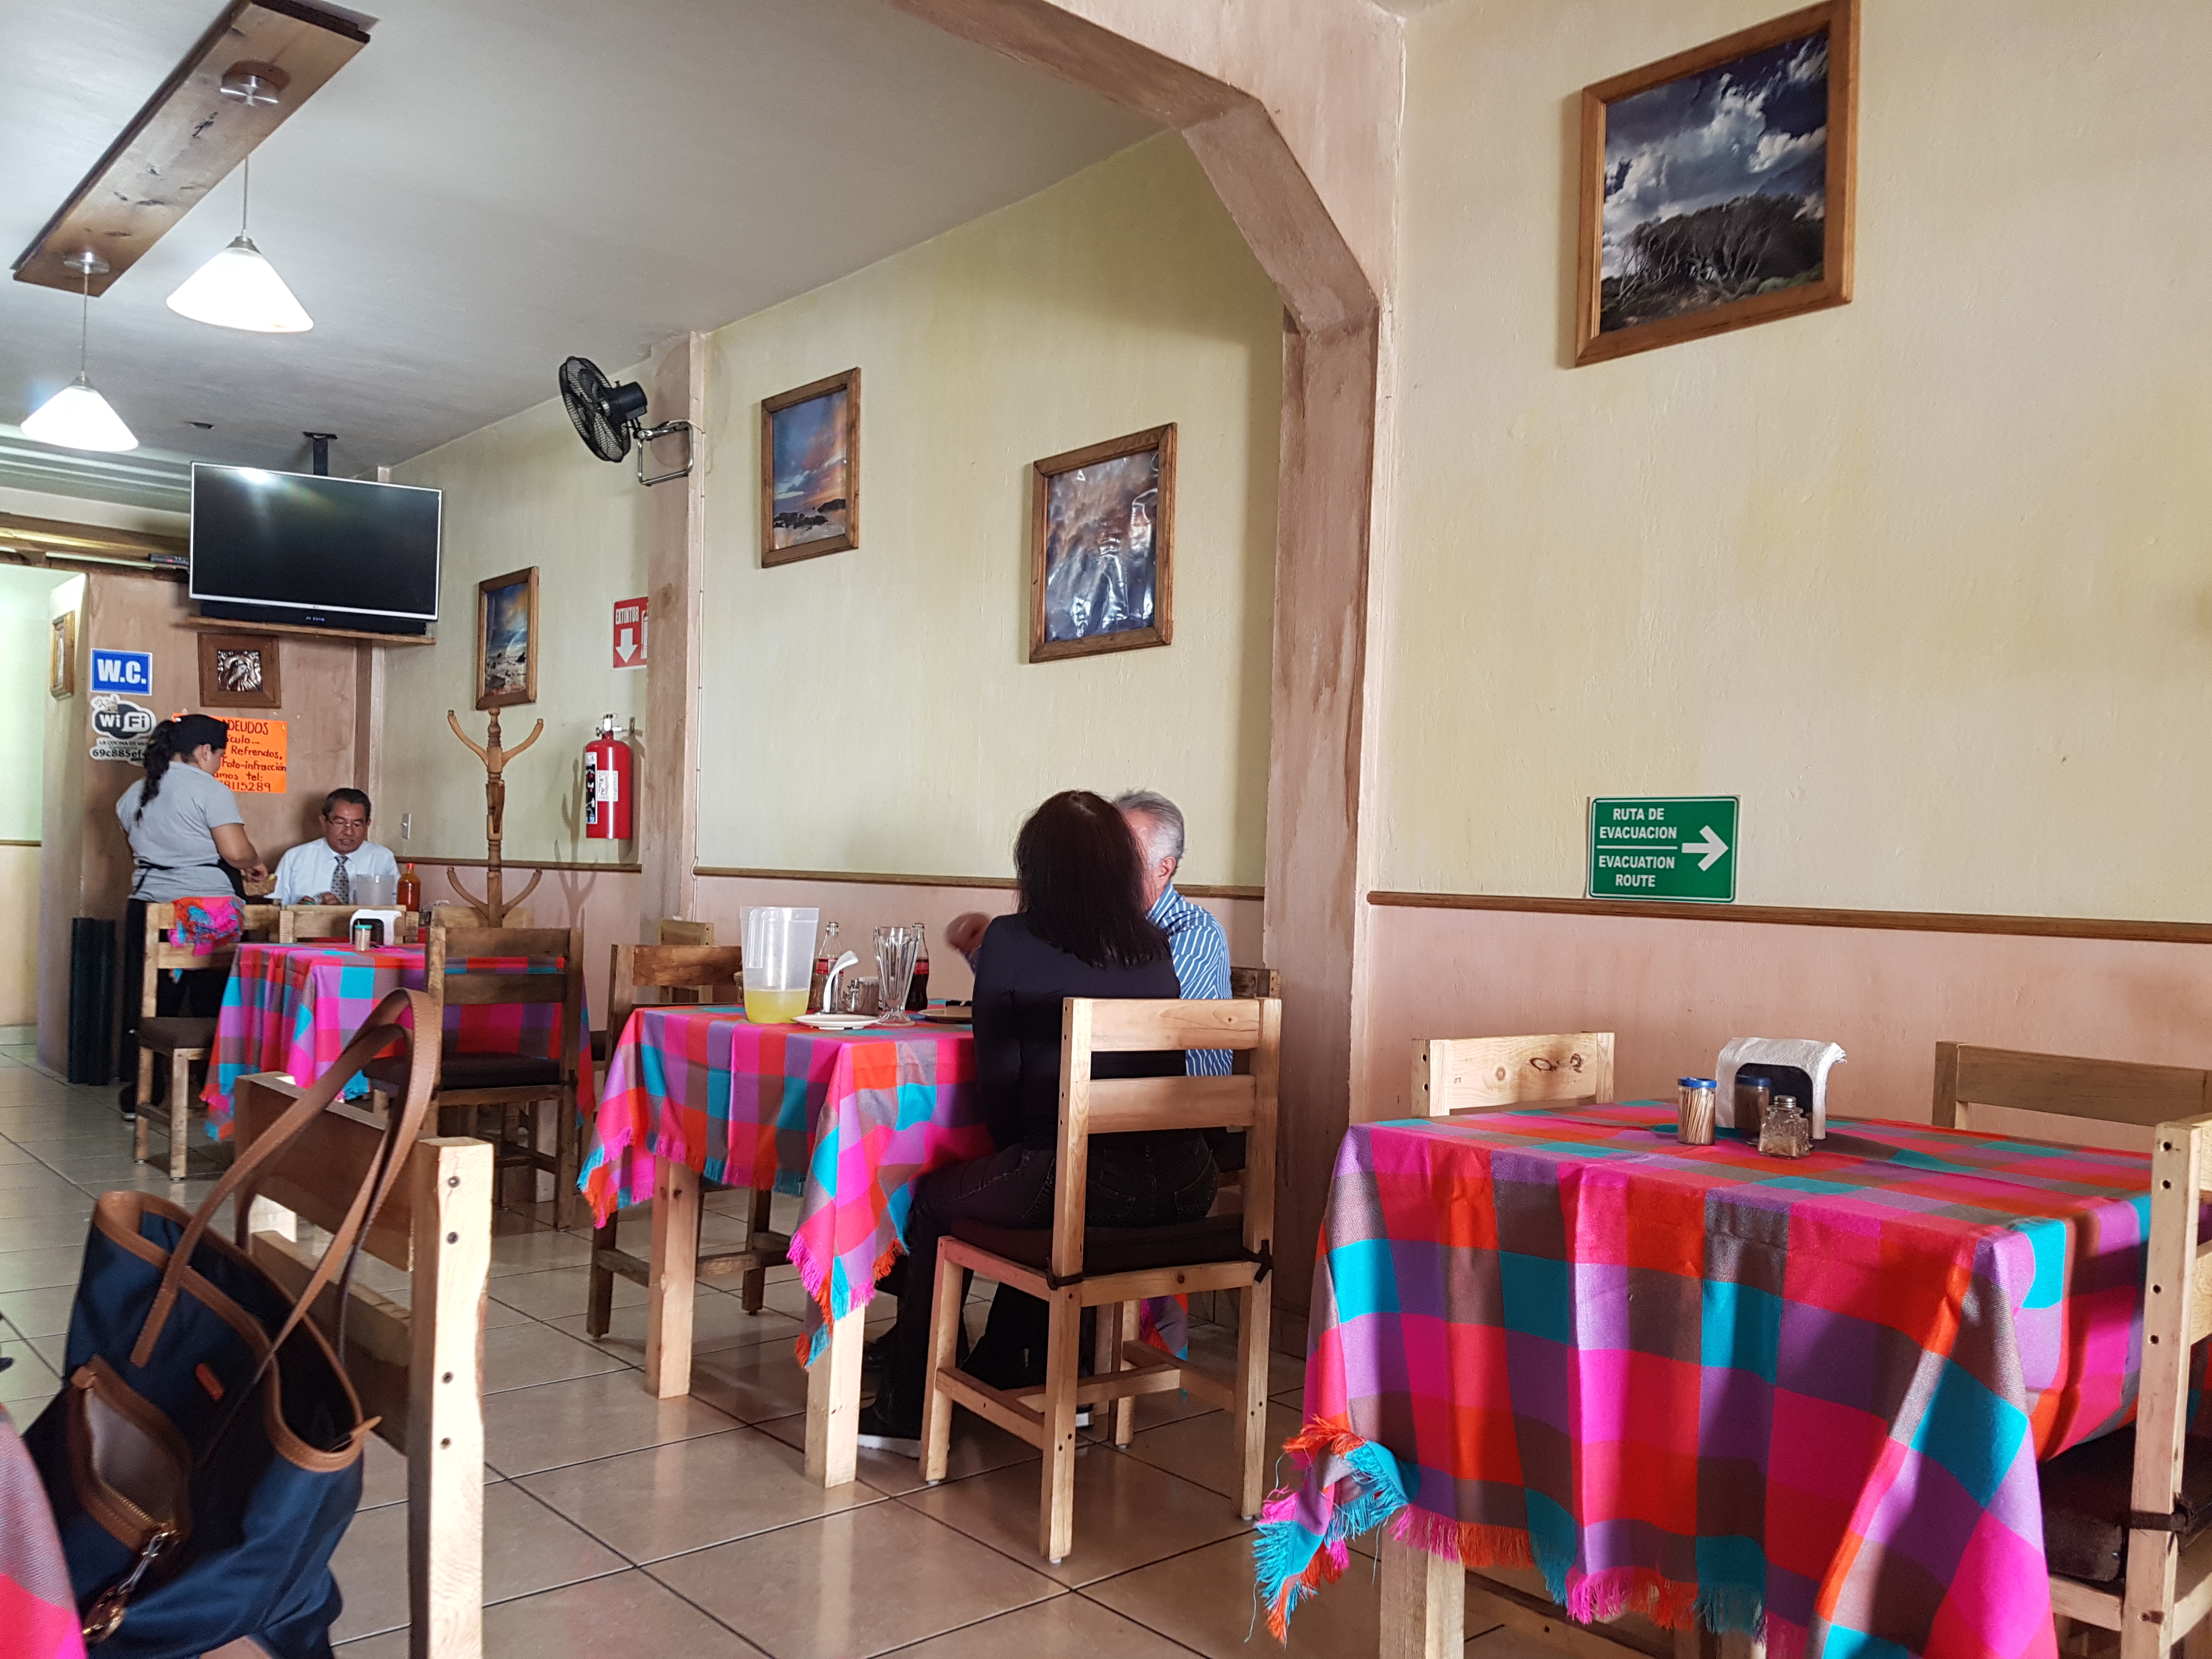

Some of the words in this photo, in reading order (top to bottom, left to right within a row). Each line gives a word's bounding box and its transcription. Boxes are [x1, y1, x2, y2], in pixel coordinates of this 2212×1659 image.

[616, 606, 639, 625] EXTINTOR
[97, 658, 146, 684] W.C.
[246, 771, 263, 781] tel:
[221, 780, 271, 792] 8115289
[1613, 808, 1645, 820] RUTA
[1648, 808, 1665, 820] DE
[1599, 826, 1677, 839] EVACUACION
[1599, 855, 1675, 868] EVACUATION
[1615, 874, 1656, 887] ROUTE
